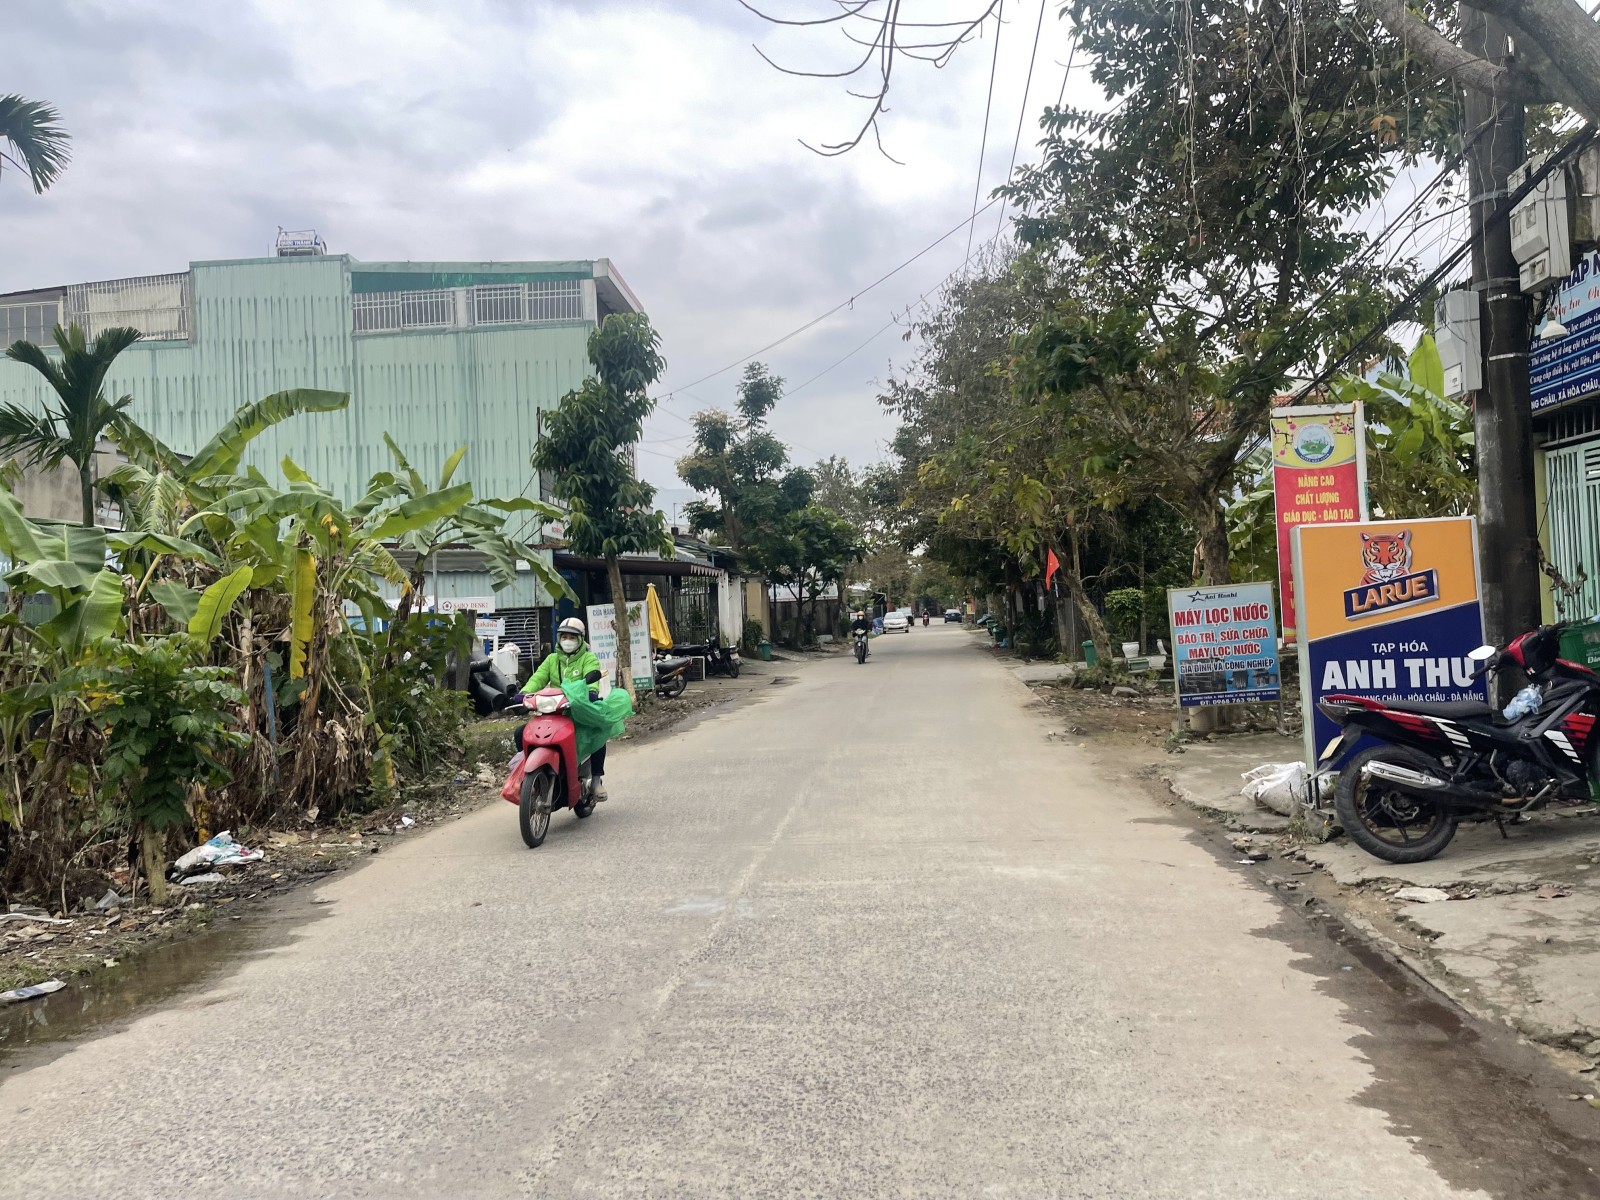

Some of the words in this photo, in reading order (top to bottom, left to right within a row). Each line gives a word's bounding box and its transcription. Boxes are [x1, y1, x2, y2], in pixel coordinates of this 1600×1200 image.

[1566, 384, 1581, 398] HÒA
[1298, 474, 1318, 488] NÂNG
[1320, 474, 1335, 487] CAO
[1295, 490, 1313, 505] CHẤT
[1315, 491, 1340, 506] LƯỢNG
[1283, 509, 1300, 523] GIÁO
[1301, 510, 1317, 524] DỤC
[1323, 507, 1338, 522] ĐÀO
[1339, 508, 1354, 522] TẠO
[1351, 575, 1429, 612] LARUE
[1174, 608, 1202, 627] MÁY
[1205, 607, 1230, 627] LỌC
[1232, 602, 1269, 622] NƯỚC
[1177, 630, 1197, 645] BẢO
[1220, 627, 1240, 641] SỬA
[1242, 627, 1269, 640] CHỮA
[1188, 646, 1210, 659] MÁY
[1212, 645, 1231, 659] LỌC
[1233, 643, 1261, 655] NƯỚC
[1372, 642, 1396, 656] TẠP
[1399, 639, 1429, 652] HÓA
[1180, 665, 1193, 674] GIA
[1194, 661, 1212, 673] ĐÌNH
[1213, 661, 1225, 672] VÀ
[1224, 659, 1245, 670] CÔNG
[1246, 657, 1274, 670] NGHIỆP
[1321, 659, 1396, 690] ANH
[1407, 690, 1423, 702] HÒA
[1424, 691, 1446, 702] CHÂU
[1450, 691, 1462, 701] ĐÀ
[1462, 689, 1484, 701] NẴNG
